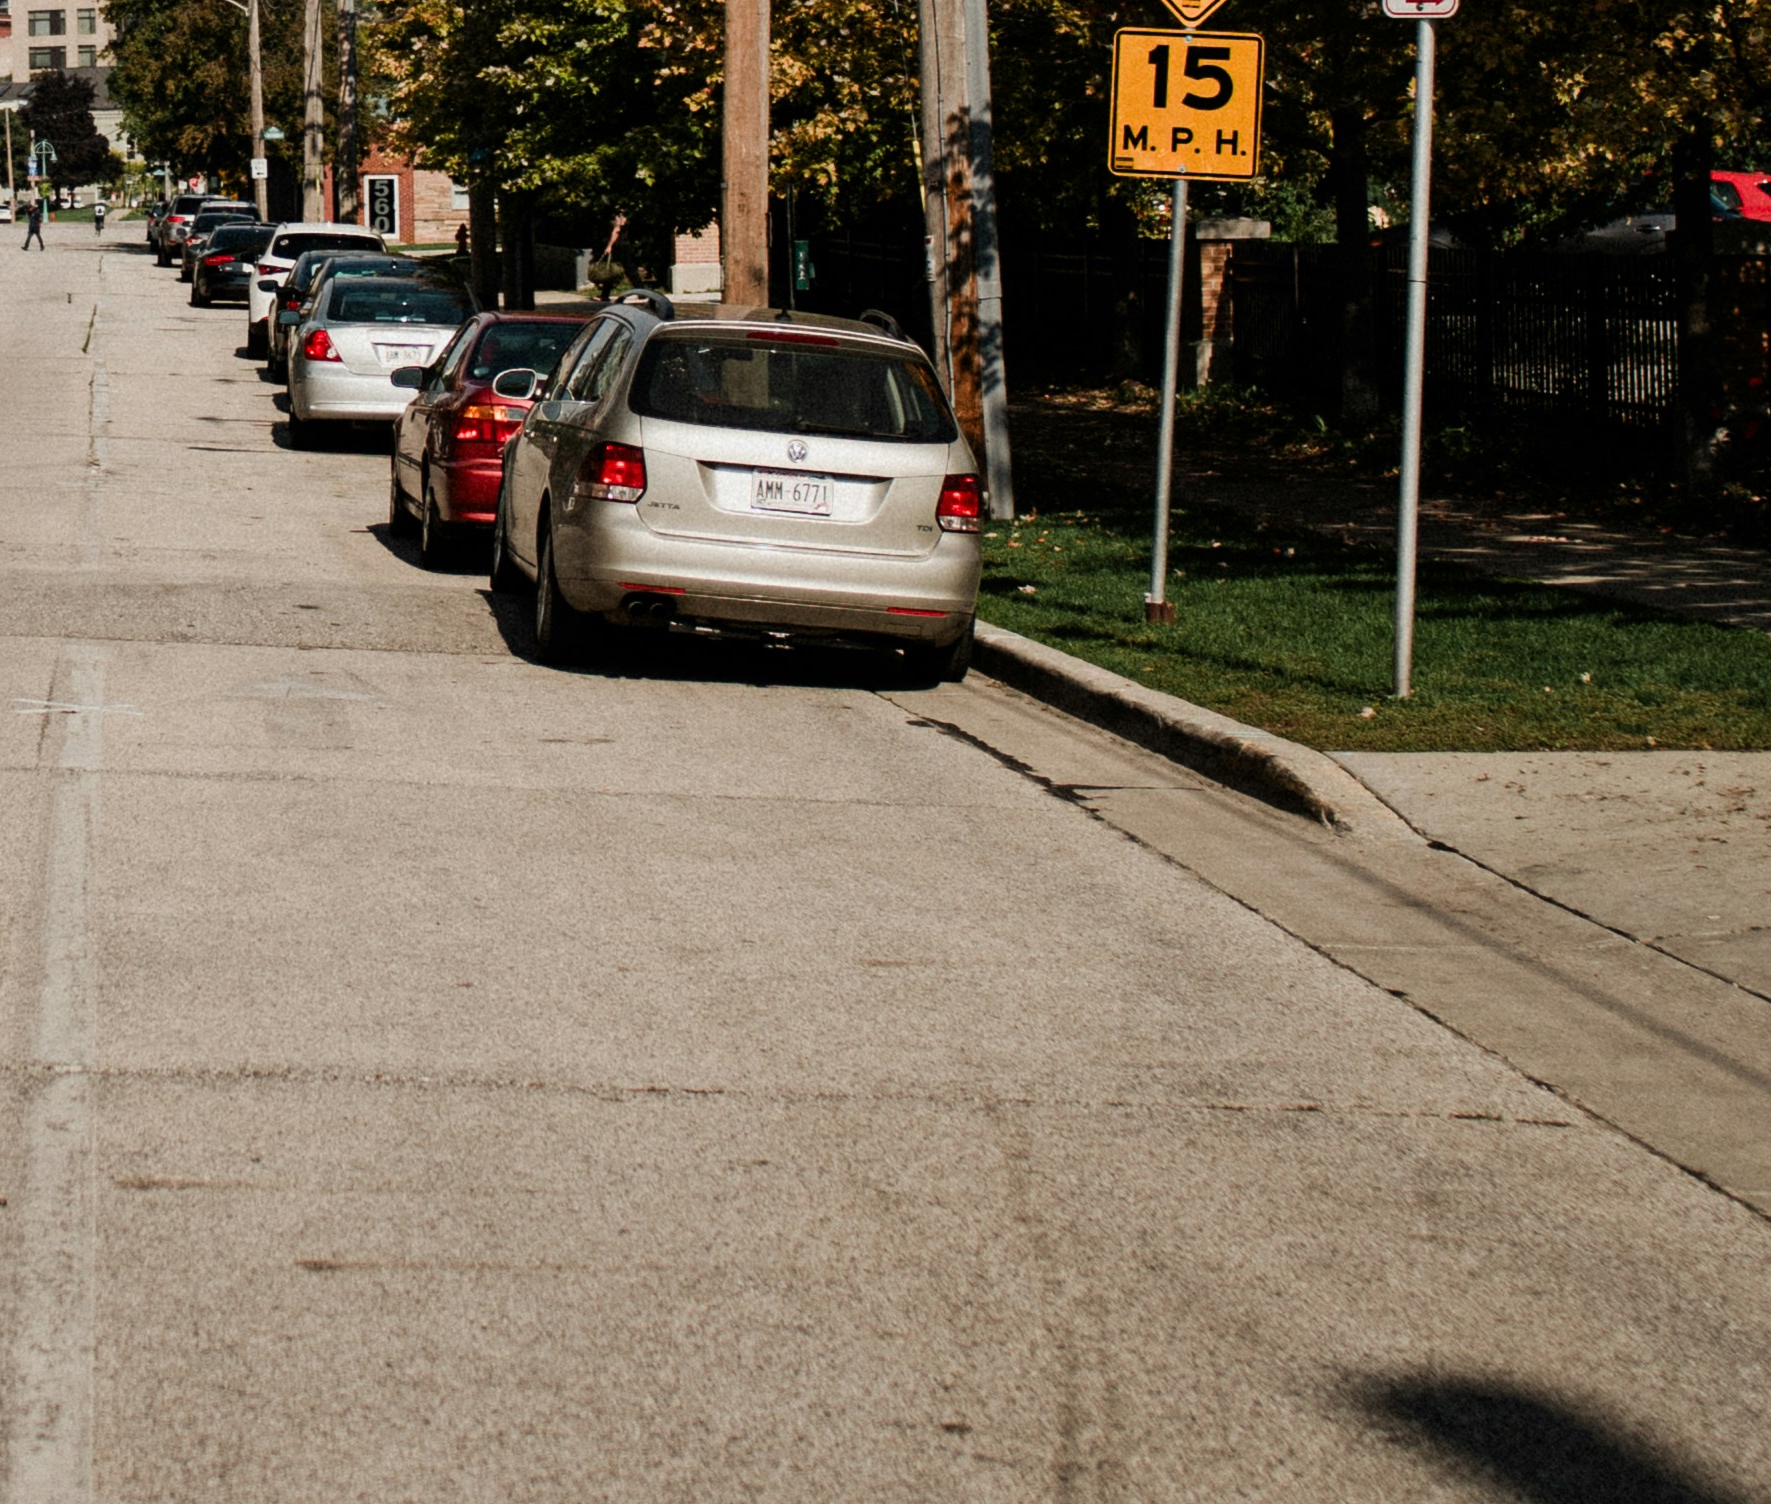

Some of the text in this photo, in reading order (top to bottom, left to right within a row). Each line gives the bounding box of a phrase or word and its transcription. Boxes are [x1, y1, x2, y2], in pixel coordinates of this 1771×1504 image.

[1148, 44, 1234, 111] 15
[374, 179, 391, 233] 560
[755, 479, 828, 504] AMM-6771
